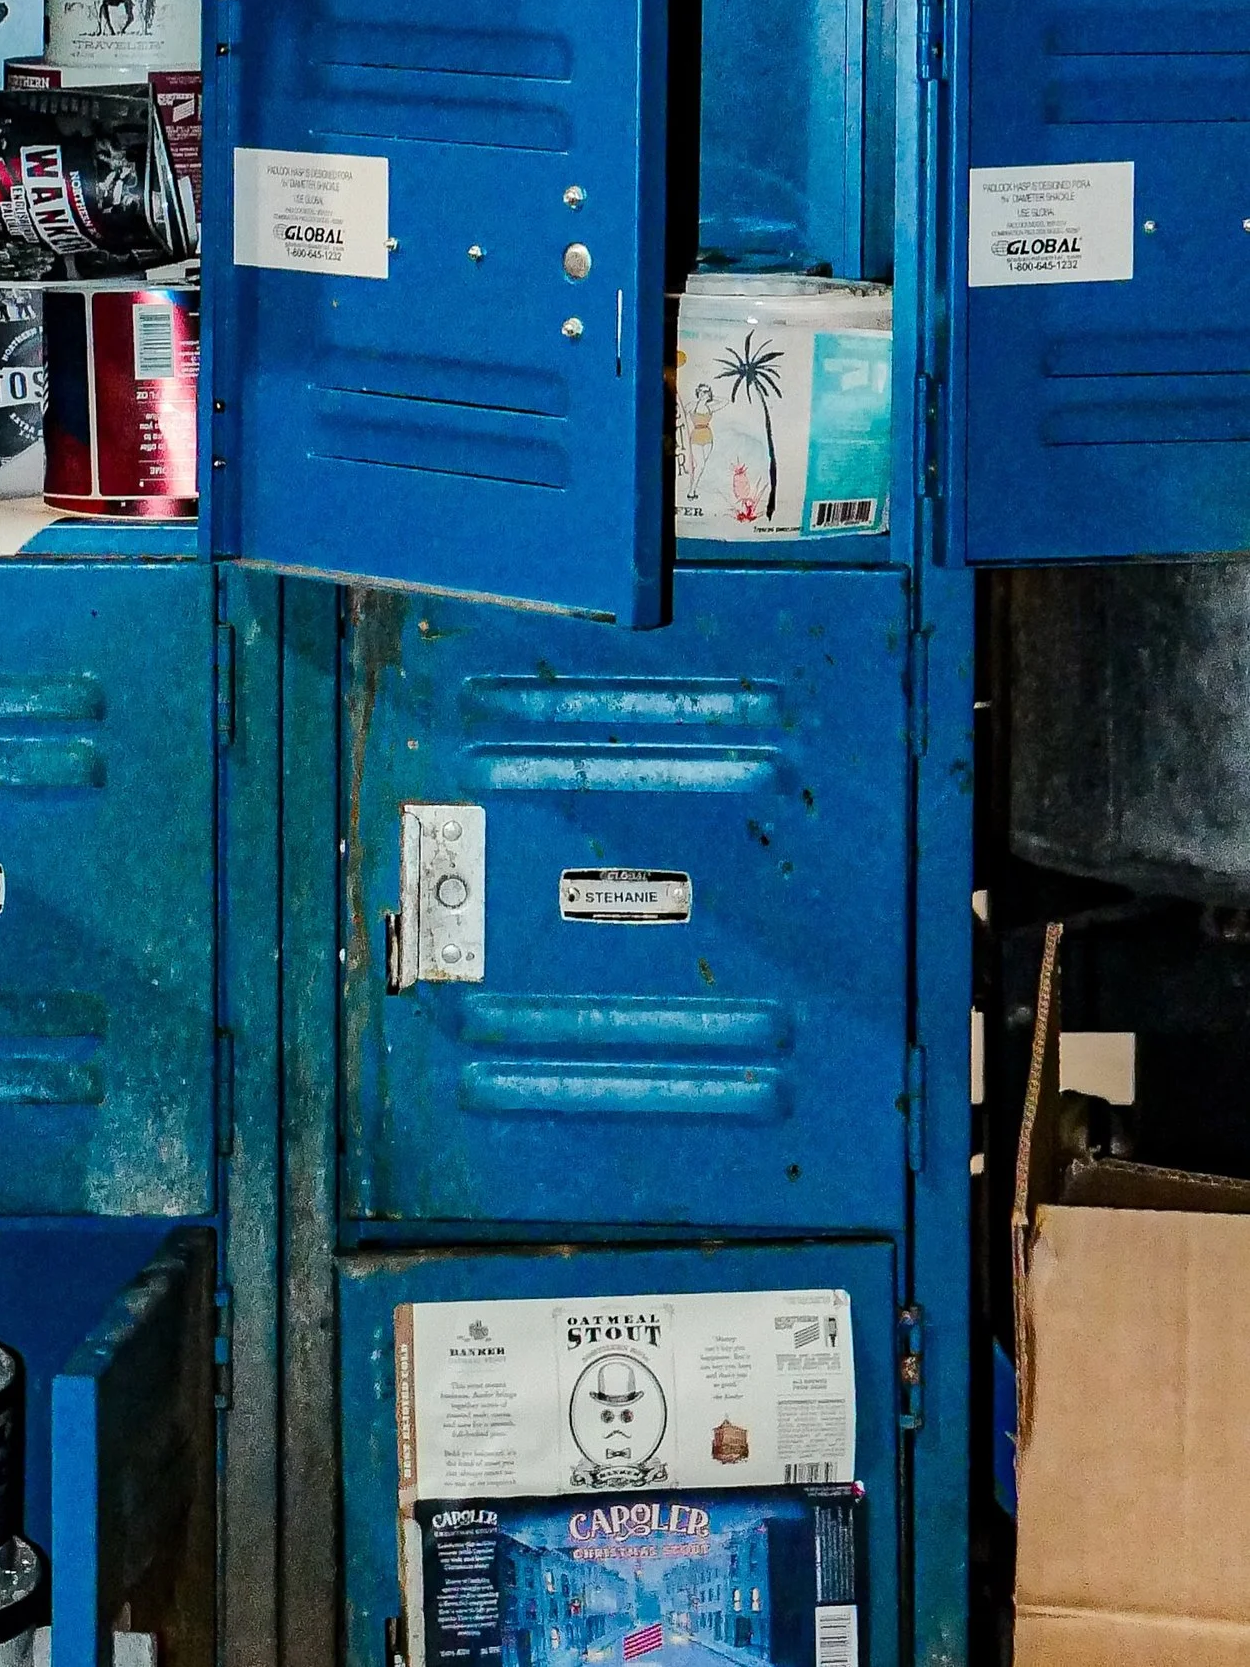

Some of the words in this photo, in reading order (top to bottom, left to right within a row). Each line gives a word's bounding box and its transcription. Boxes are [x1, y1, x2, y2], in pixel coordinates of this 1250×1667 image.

[9, 75, 50, 89] RTHERN
[25, 147, 95, 258] WANKER
[285, 225, 344, 244] GLOBAL
[1007, 238, 1080, 254] GLOBAL
[1009, 261, 1078, 271] 1-800-645-1232
[585, 890, 659, 904] STEHANIE
[567, 1314, 660, 1326] OATMEAL
[567, 1326, 661, 1351] STOUT
[449, 1347, 505, 1356] BANKER
[432, 1510, 498, 1529] CAROLER
[569, 1503, 710, 1542] CAROLER
